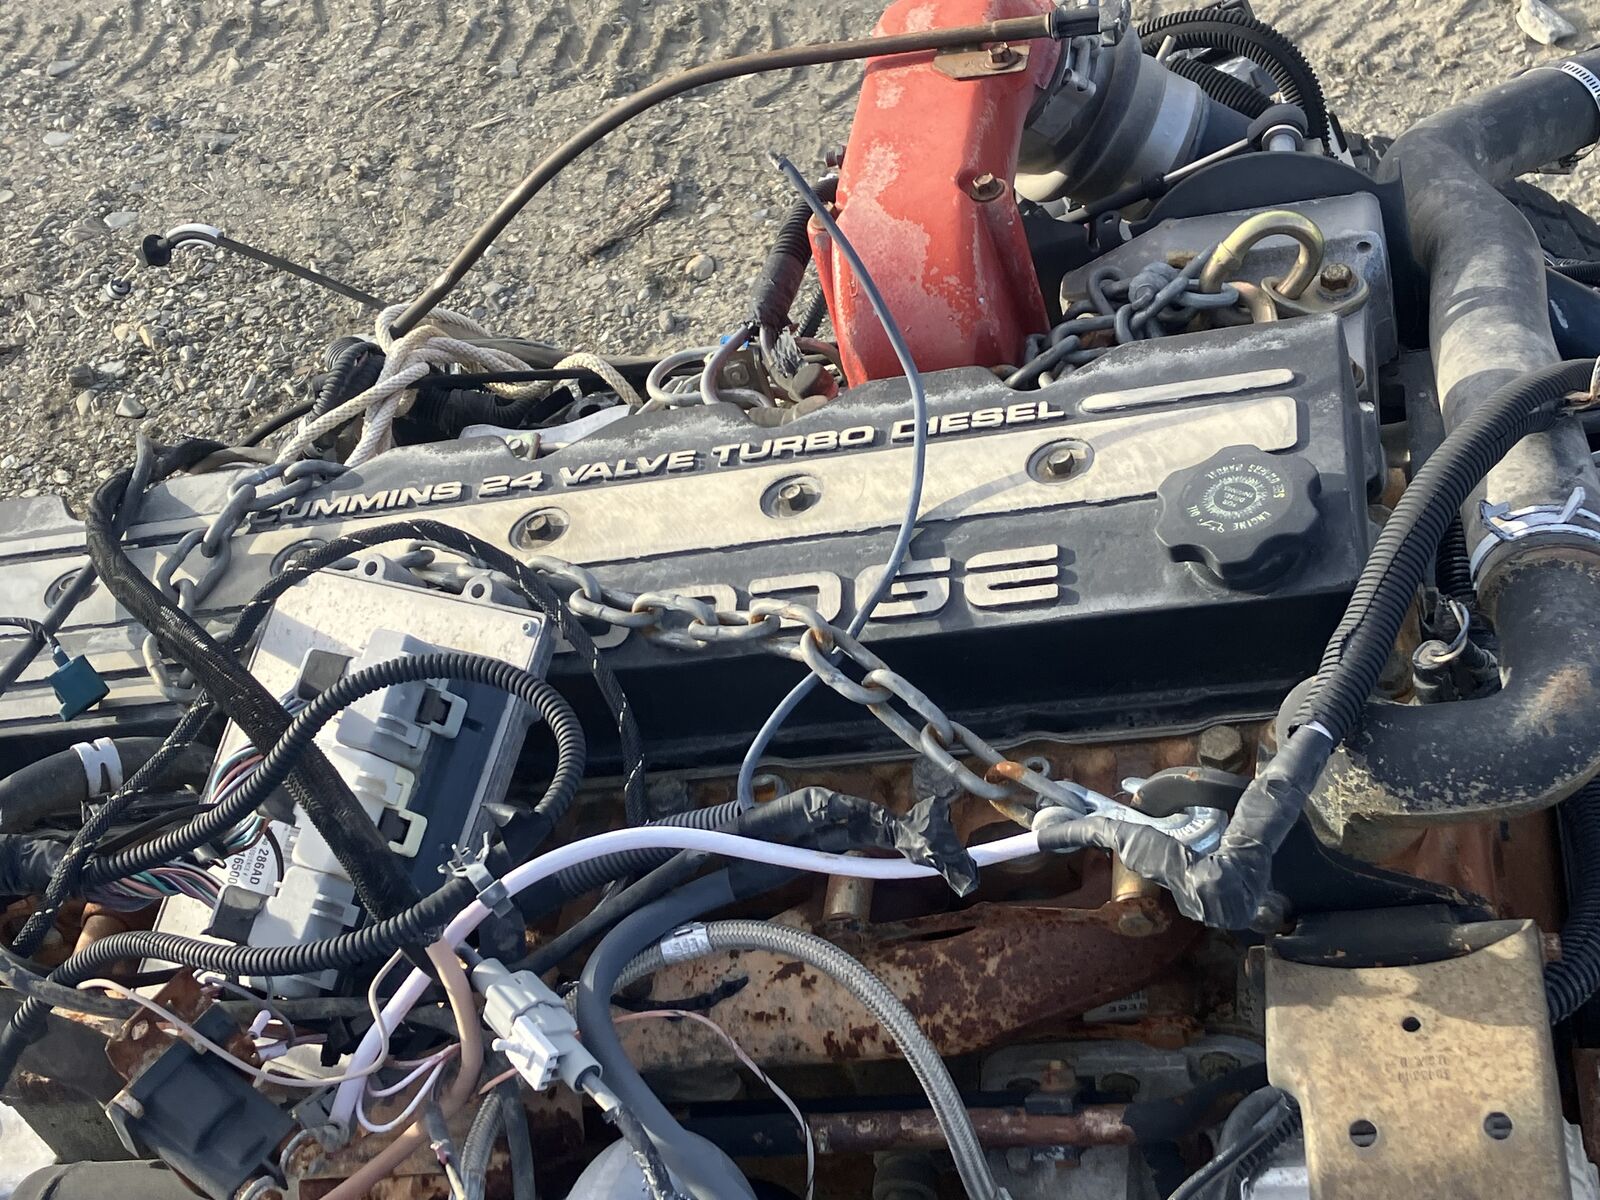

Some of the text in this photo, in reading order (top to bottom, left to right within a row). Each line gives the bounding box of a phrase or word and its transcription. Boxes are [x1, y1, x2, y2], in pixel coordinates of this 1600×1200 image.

[249, 401, 1065, 523] CUMMINS 24 VALVE TURBO DIESEL
[1187, 505, 1272, 531] ENGINE OIL
[250, 849, 270, 885] 286AD
